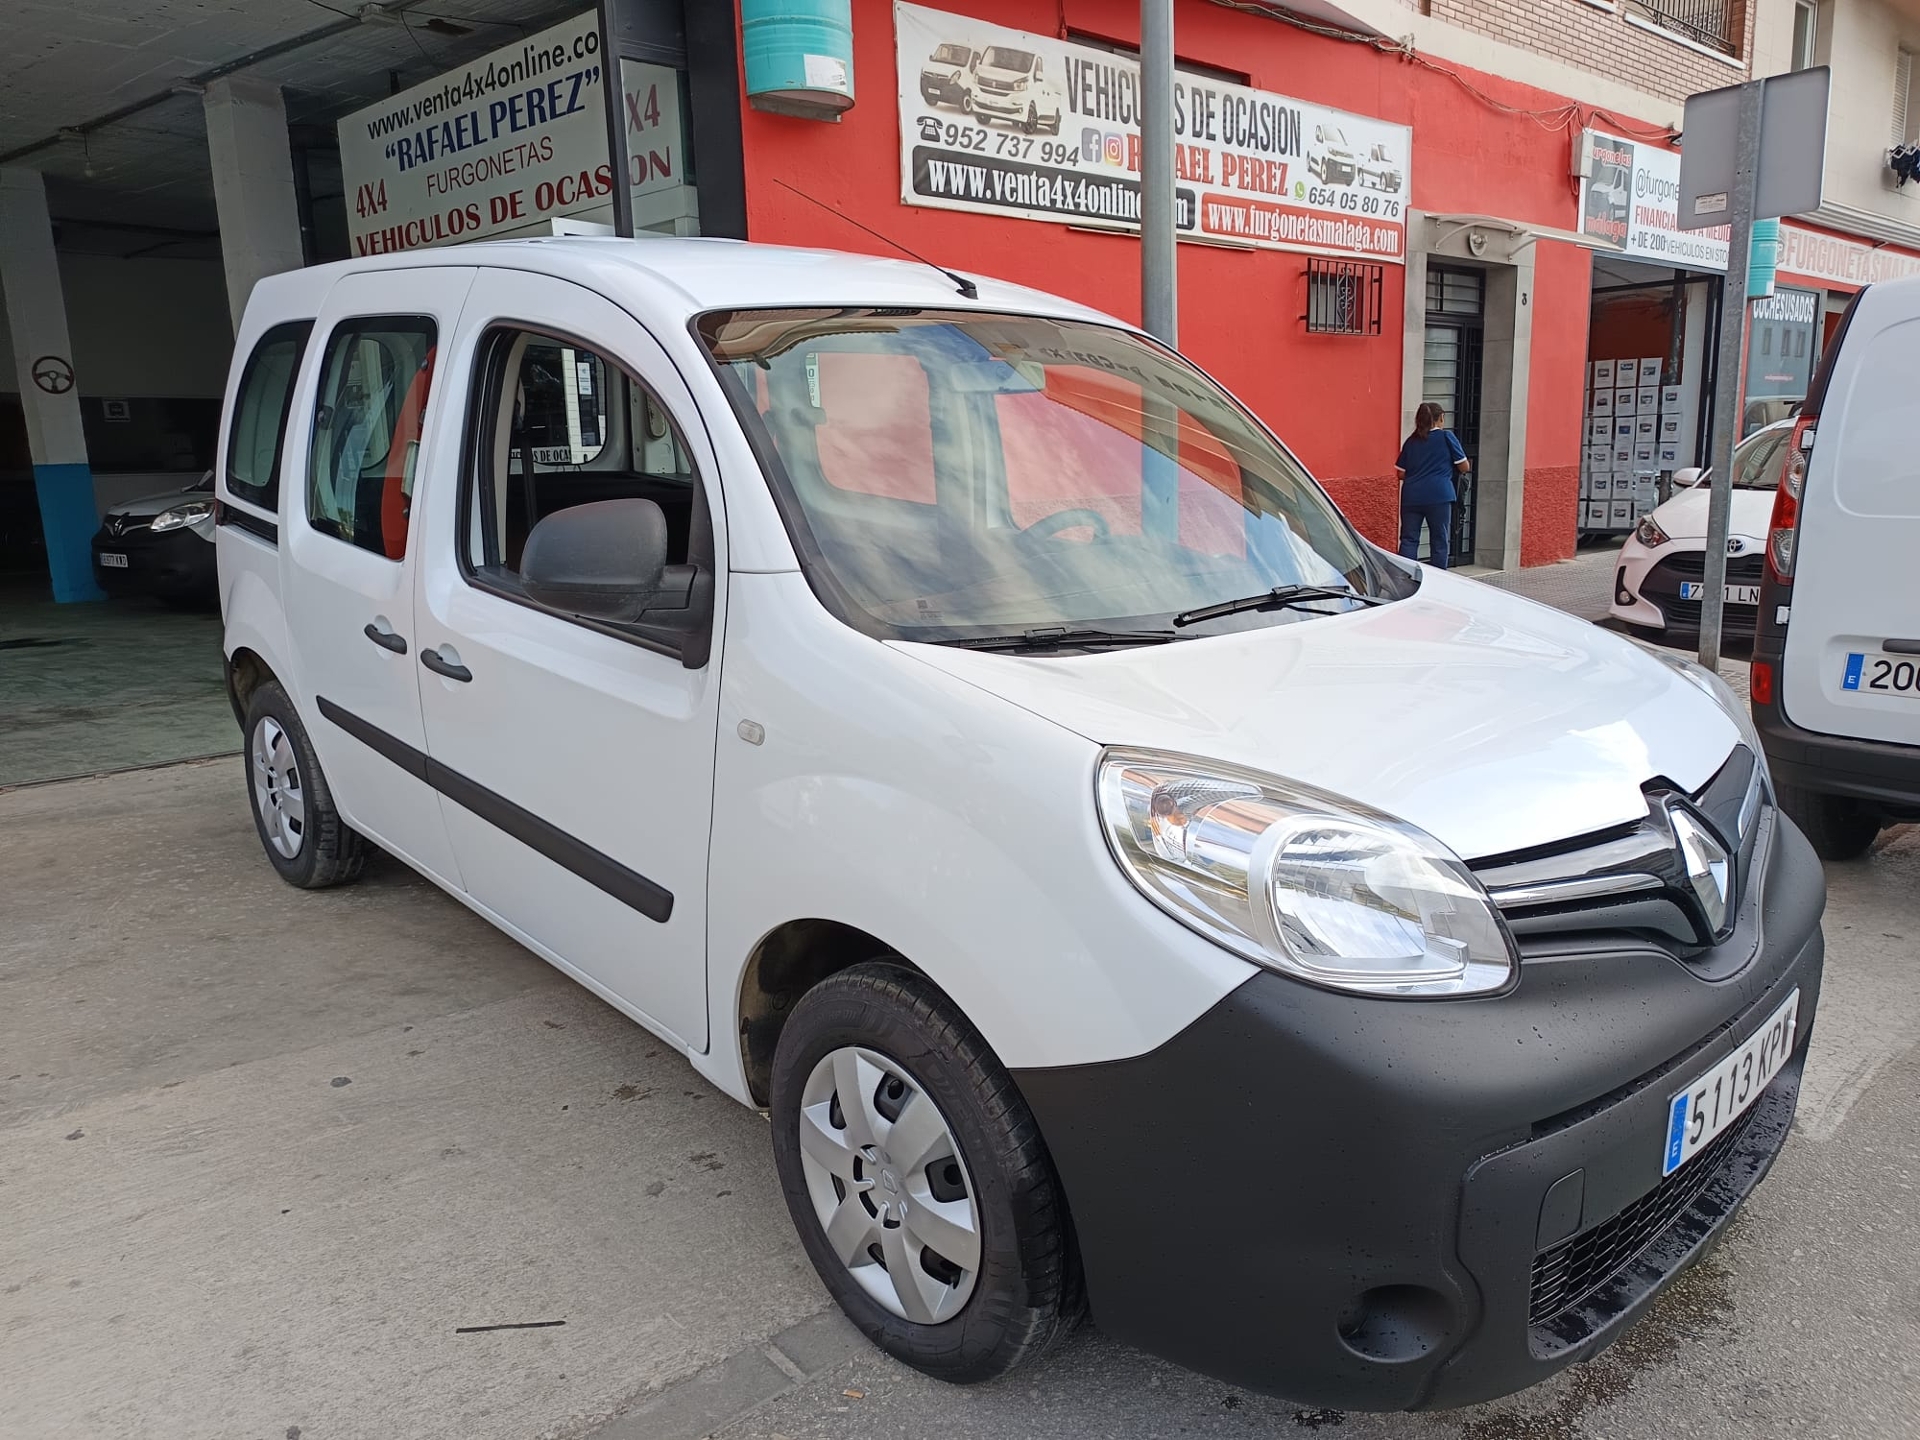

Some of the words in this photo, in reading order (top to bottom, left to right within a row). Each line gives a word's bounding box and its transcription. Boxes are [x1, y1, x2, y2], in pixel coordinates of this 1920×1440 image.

[367, 31, 599, 140] www.venta4x4online.co
[1064, 56, 1185, 135] VEHICUS
[1192, 87, 1216, 141] DE
[1222, 93, 1301, 158] OCASION
[626, 83, 660, 136] X4
[426, 136, 554, 197] FURGONETAS
[944, 123, 988, 152] 952
[996, 132, 1034, 159] 737
[1040, 141, 1080, 167] 994
[1127, 133, 1213, 184] RAEL
[1221, 151, 1289, 196] PEREZ
[1592, 146, 1632, 168] urgonetas
[356, 178, 388, 219] 4X4
[356, 203, 482, 257] VEHICULOS
[490, 190, 527, 225] DE
[534, 145, 673, 211] OCASON
[928, 159, 1188, 226] www.venta4x4onlinm
[1309, 186, 1335, 207] 654
[1340, 193, 1358, 211] 05
[1362, 196, 1379, 215] 80
[1383, 199, 1399, 217] 76
[1636, 168, 1680, 203] @furgone
[1207, 202, 1398, 253] www.furgonetasmalaga.com
[1631, 234, 1637, 247] +
[1638, 231, 1648, 248] DE
[1666, 239, 1704, 260] VEHICULOS
[1705, 246, 1715, 261] EN
[1715, 248, 1730, 263] STO
[1635, 205, 1696, 236] FINANCIA
[1706, 224, 1732, 242] MEDID
[1690, 584, 1730, 601] 71
[1738, 587, 1759, 602] LN
[1869, 660, 1920, 691] 20
[1689, 1051, 1753, 1145] 5113
